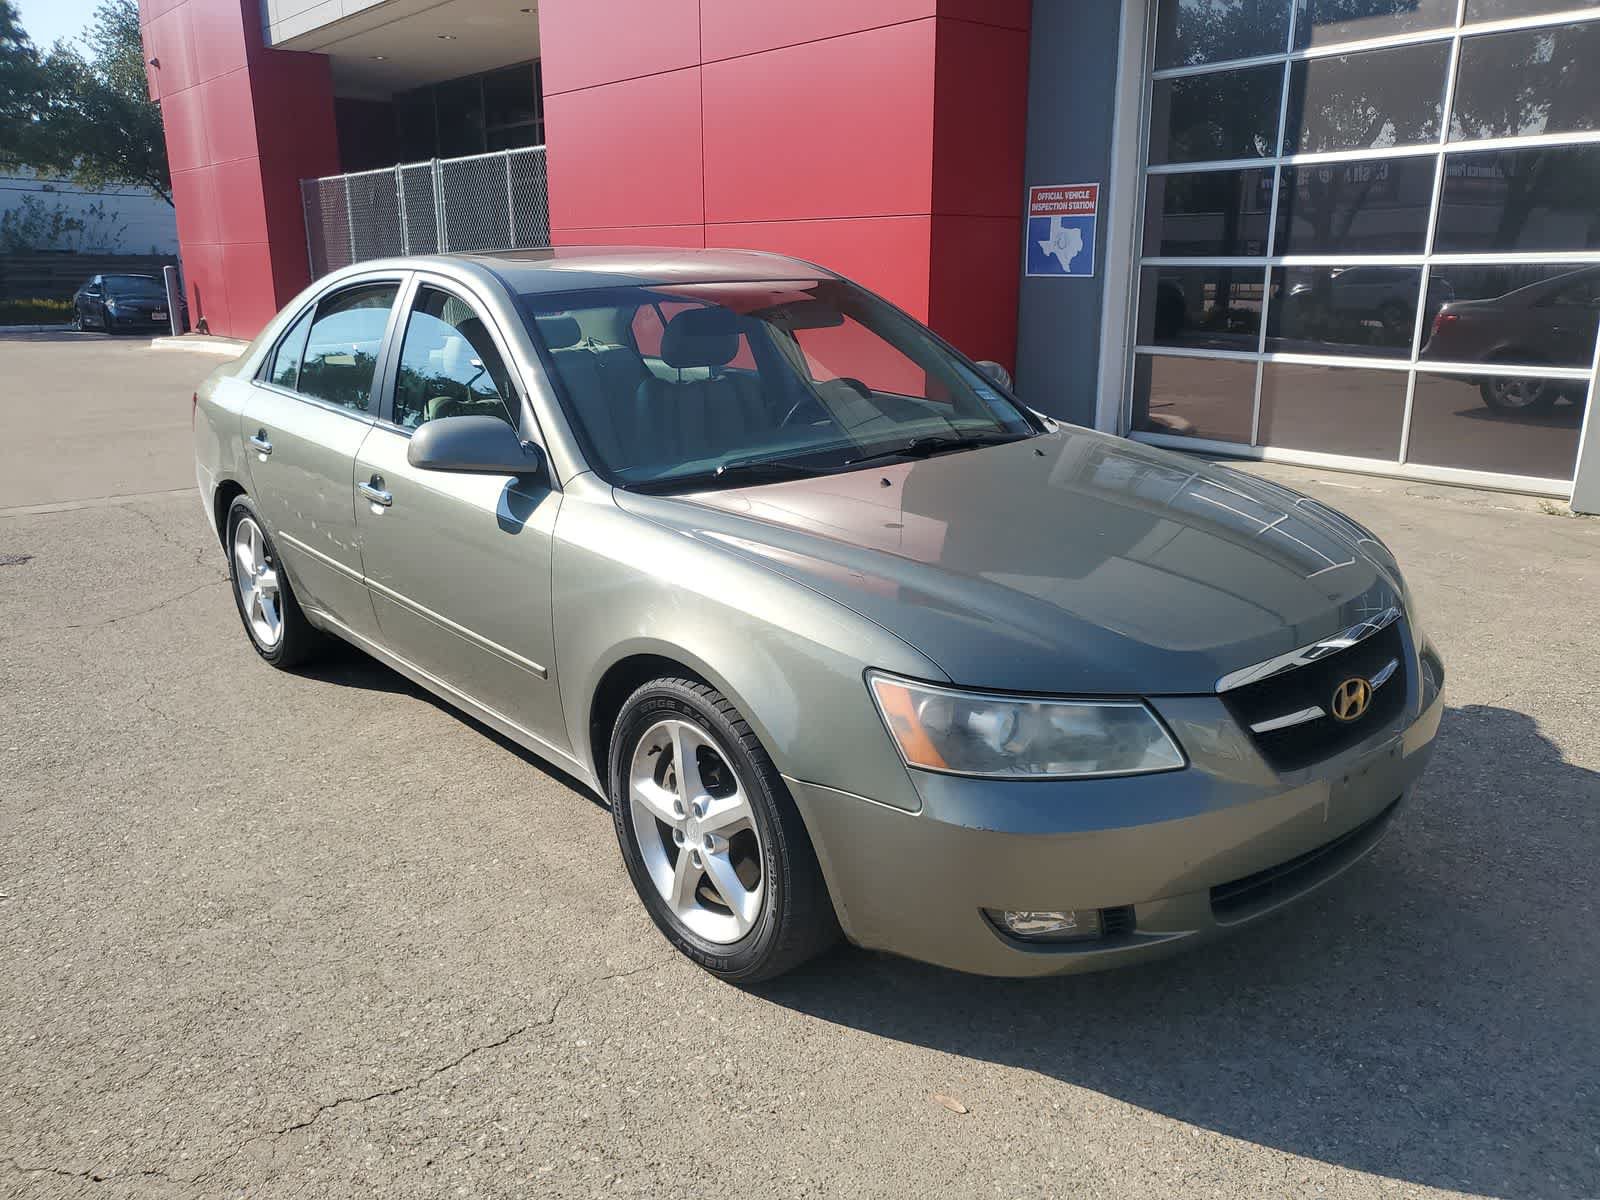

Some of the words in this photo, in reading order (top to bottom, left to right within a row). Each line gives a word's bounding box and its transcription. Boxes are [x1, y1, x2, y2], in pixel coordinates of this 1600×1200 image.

[1037, 191, 1063, 200] OFFICIAL
[1065, 191, 1090, 200] VEHICLE
[1032, 202, 1067, 211] INSPECTION
[1069, 201, 1094, 210] STATION
